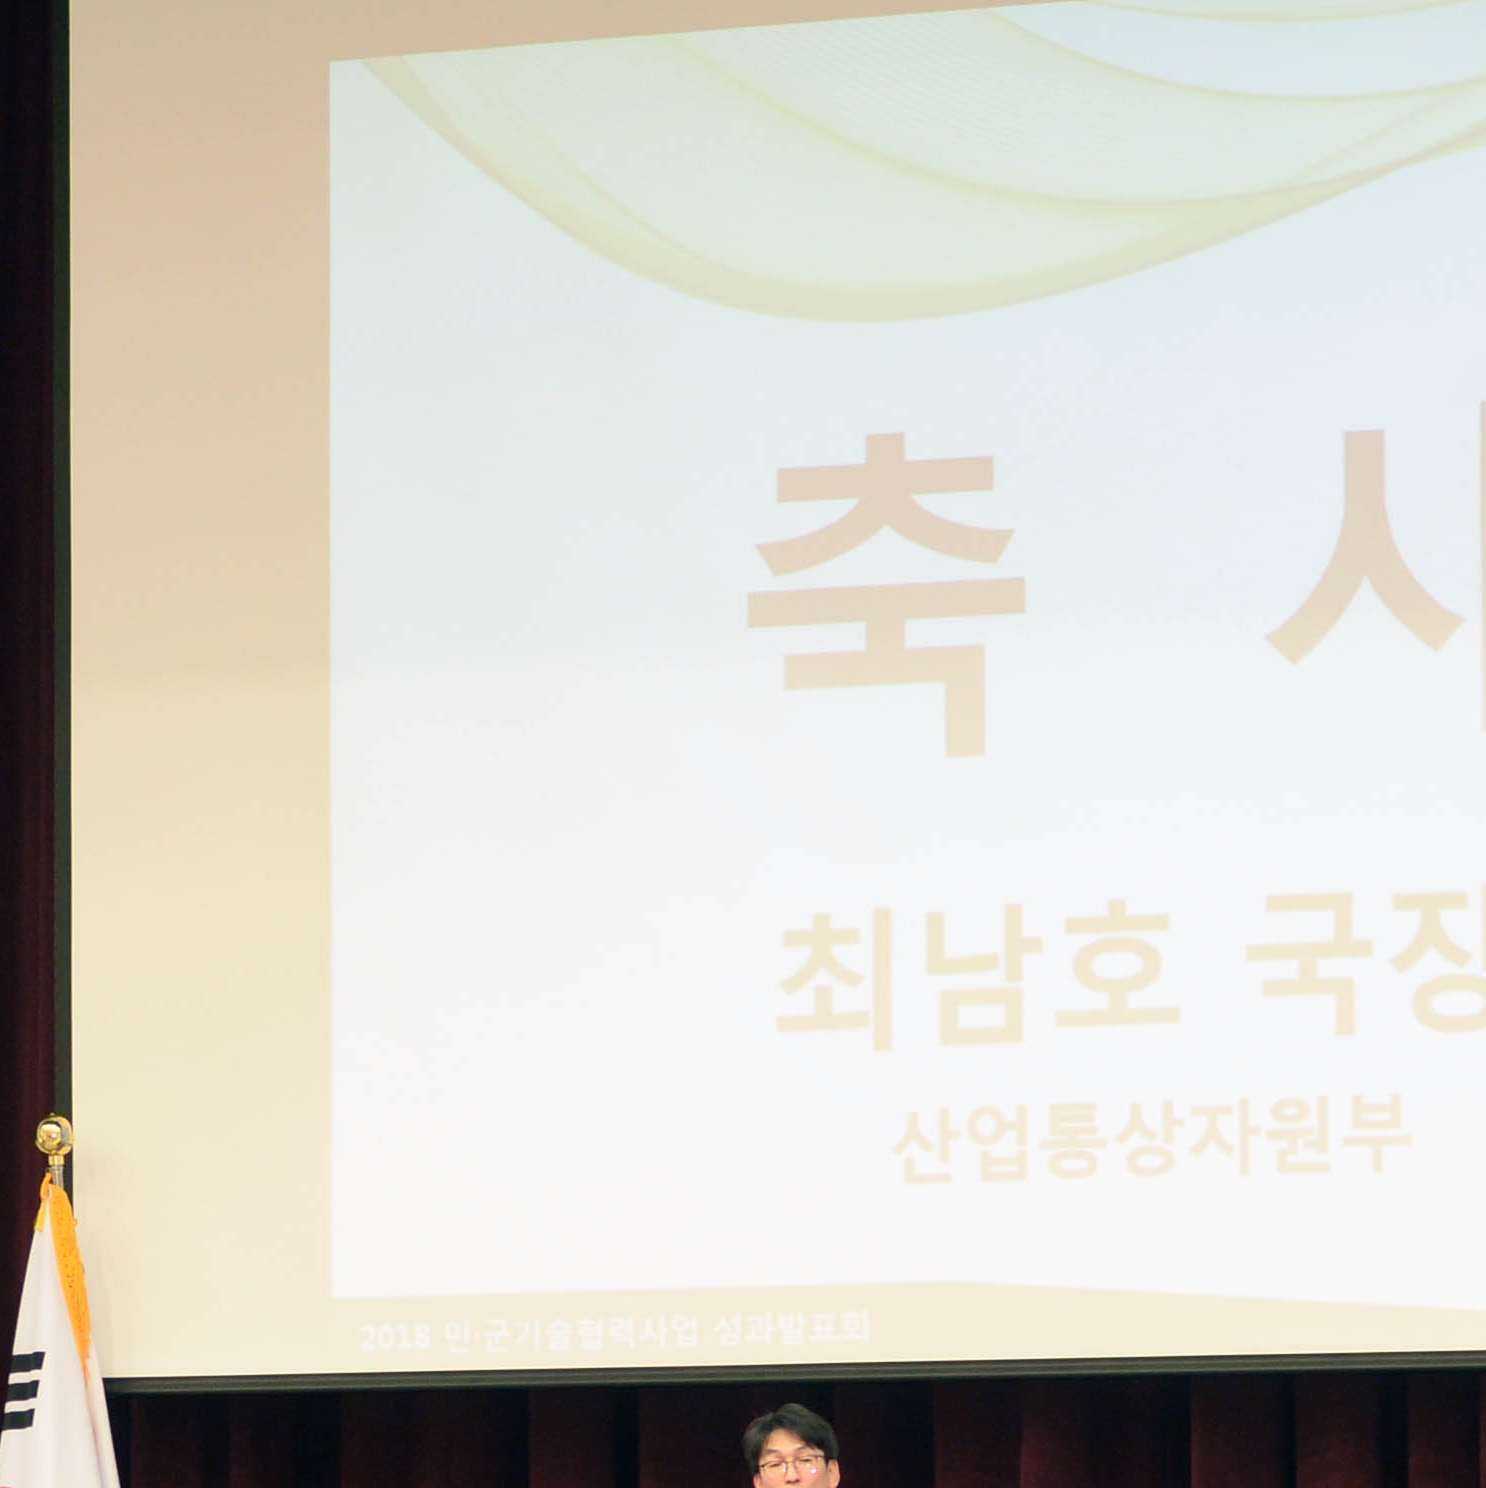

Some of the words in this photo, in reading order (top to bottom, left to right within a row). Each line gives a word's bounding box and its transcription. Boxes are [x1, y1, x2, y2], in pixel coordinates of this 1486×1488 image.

[746, 431, 1028, 758] 축
[775, 898, 1183, 1054] 최남호
[890, 1091, 1414, 1185] 산업통상자원부
[359, 1323, 433, 1352] 2018
[715, 1308, 871, 1346] 성과발표회
